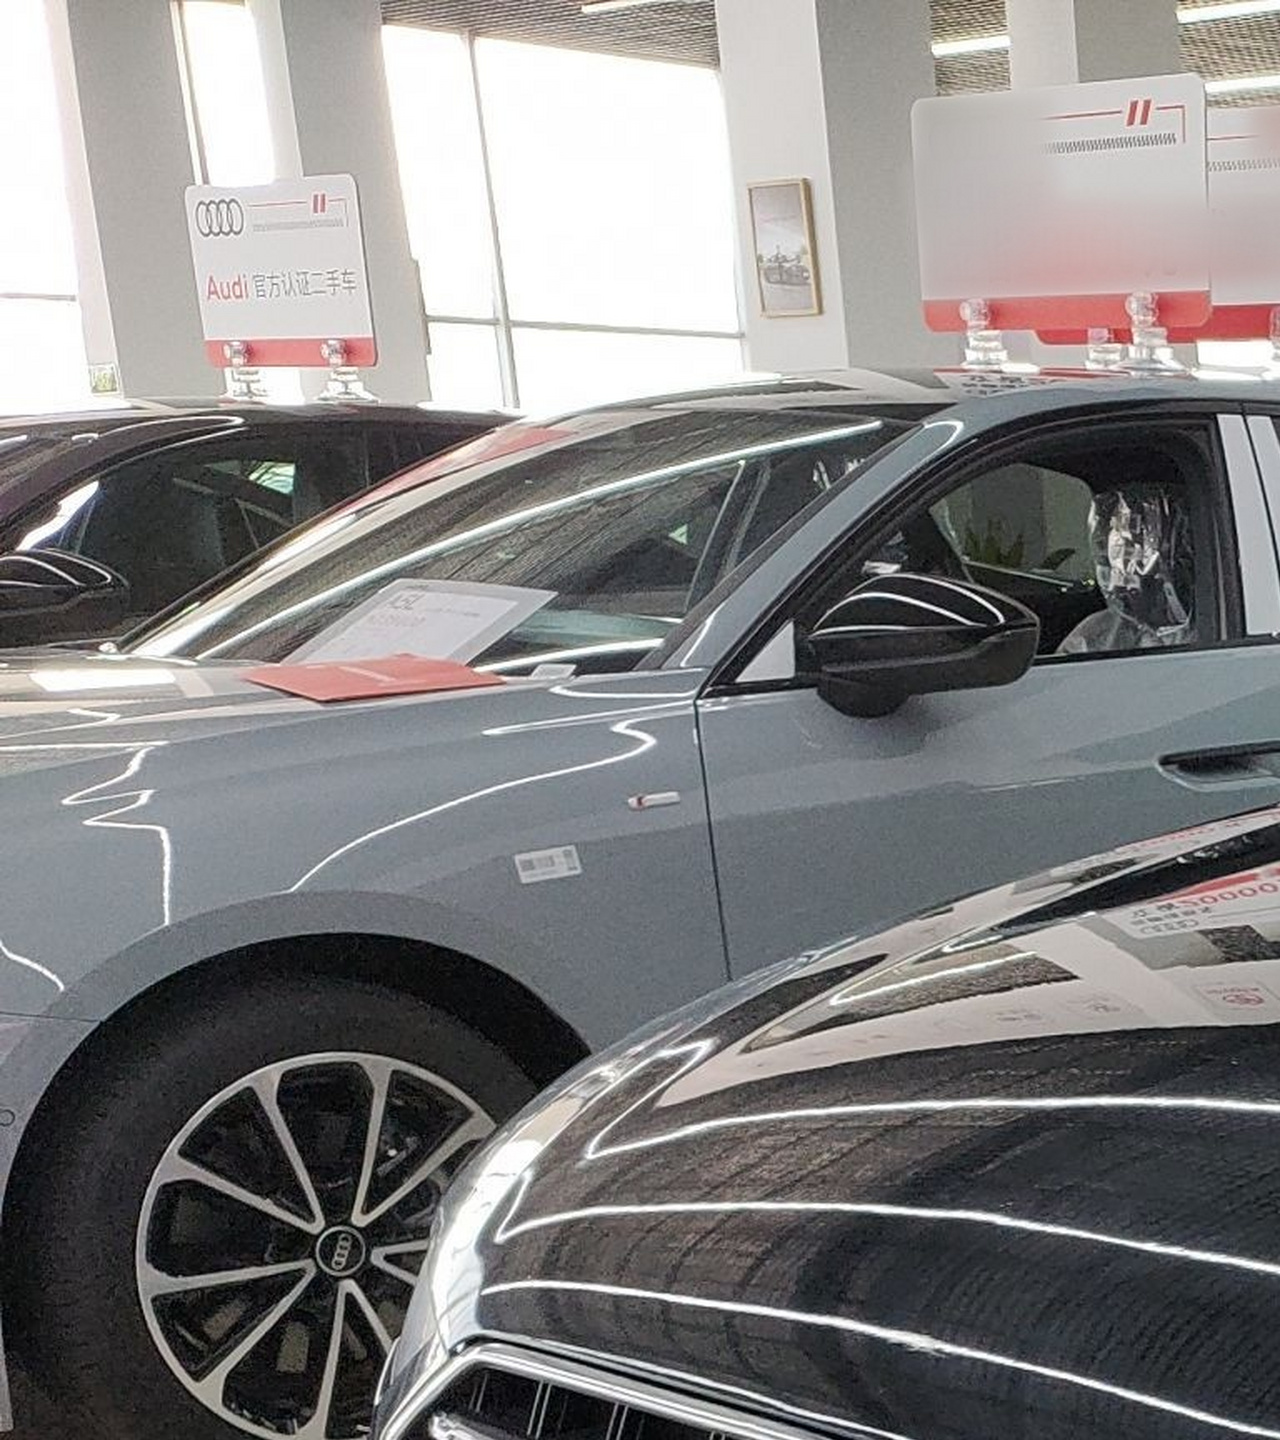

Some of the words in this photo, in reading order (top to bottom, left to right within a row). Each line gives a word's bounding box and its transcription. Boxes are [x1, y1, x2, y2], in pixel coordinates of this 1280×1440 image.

[206, 273, 249, 301] Audi
[252, 269, 356, 299] 官方认证二手车
